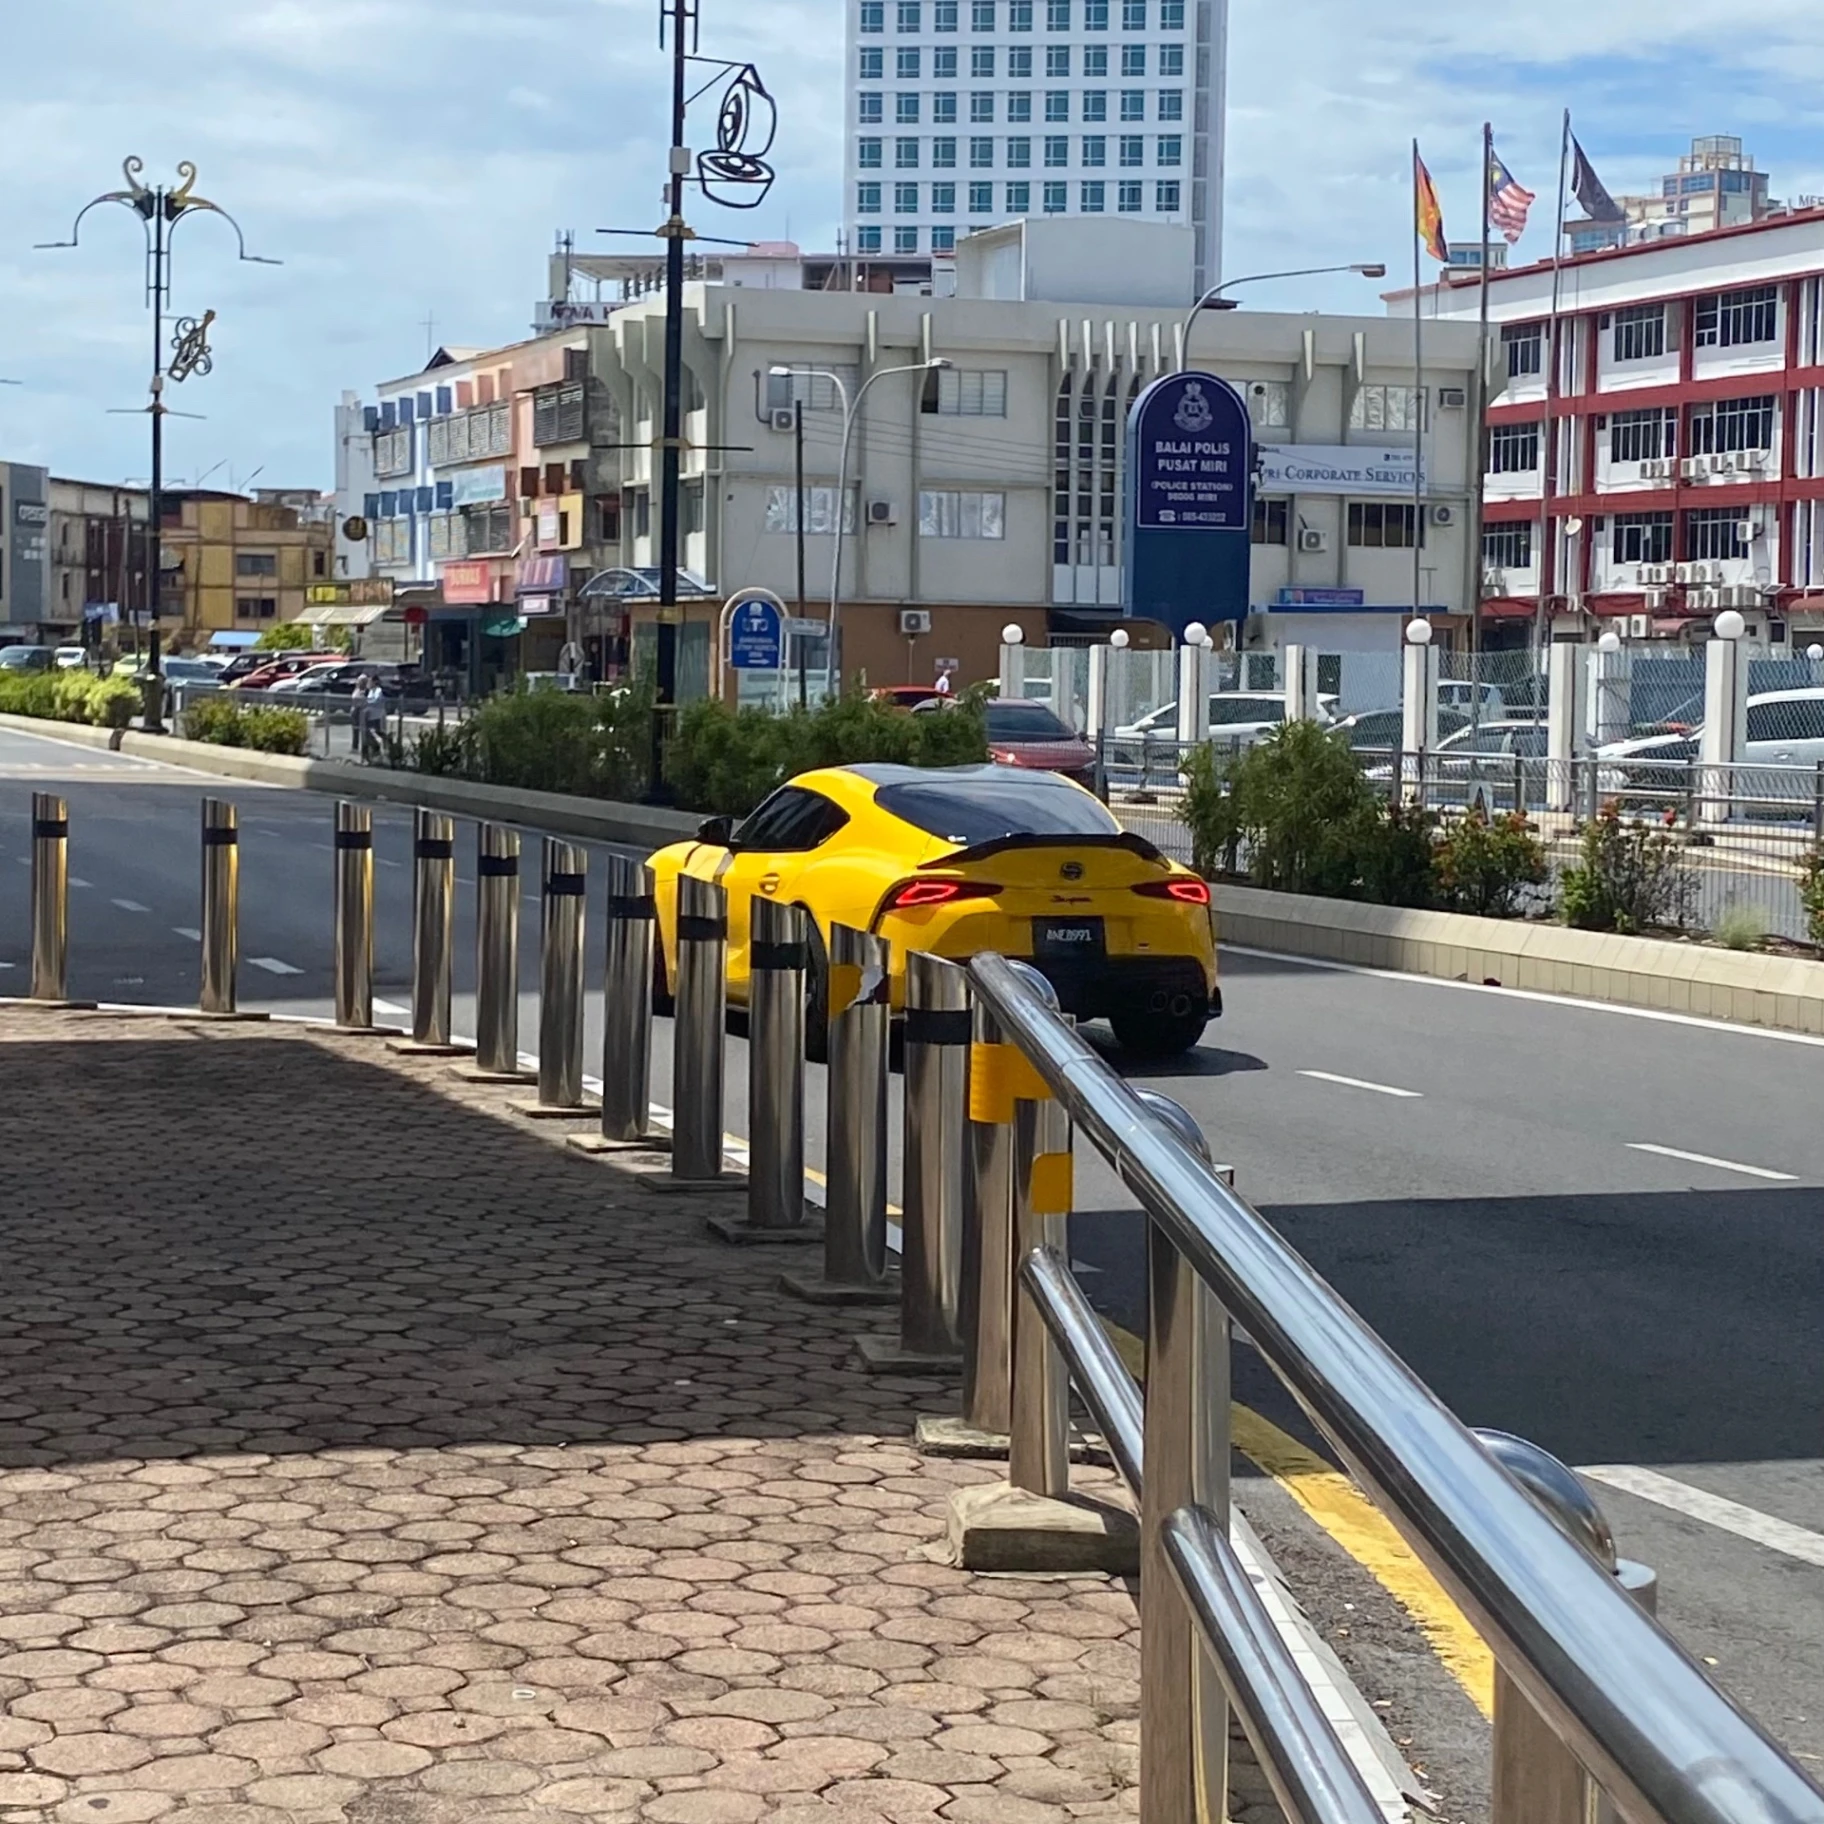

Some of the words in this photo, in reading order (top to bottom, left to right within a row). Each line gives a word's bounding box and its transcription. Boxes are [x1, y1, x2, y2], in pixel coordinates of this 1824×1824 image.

[1155, 441, 1191, 454] BALAI
[1194, 442, 1230, 455] POLIS
[1157, 459, 1197, 471] PUSAT
[1200, 460, 1228, 473] MIRI
